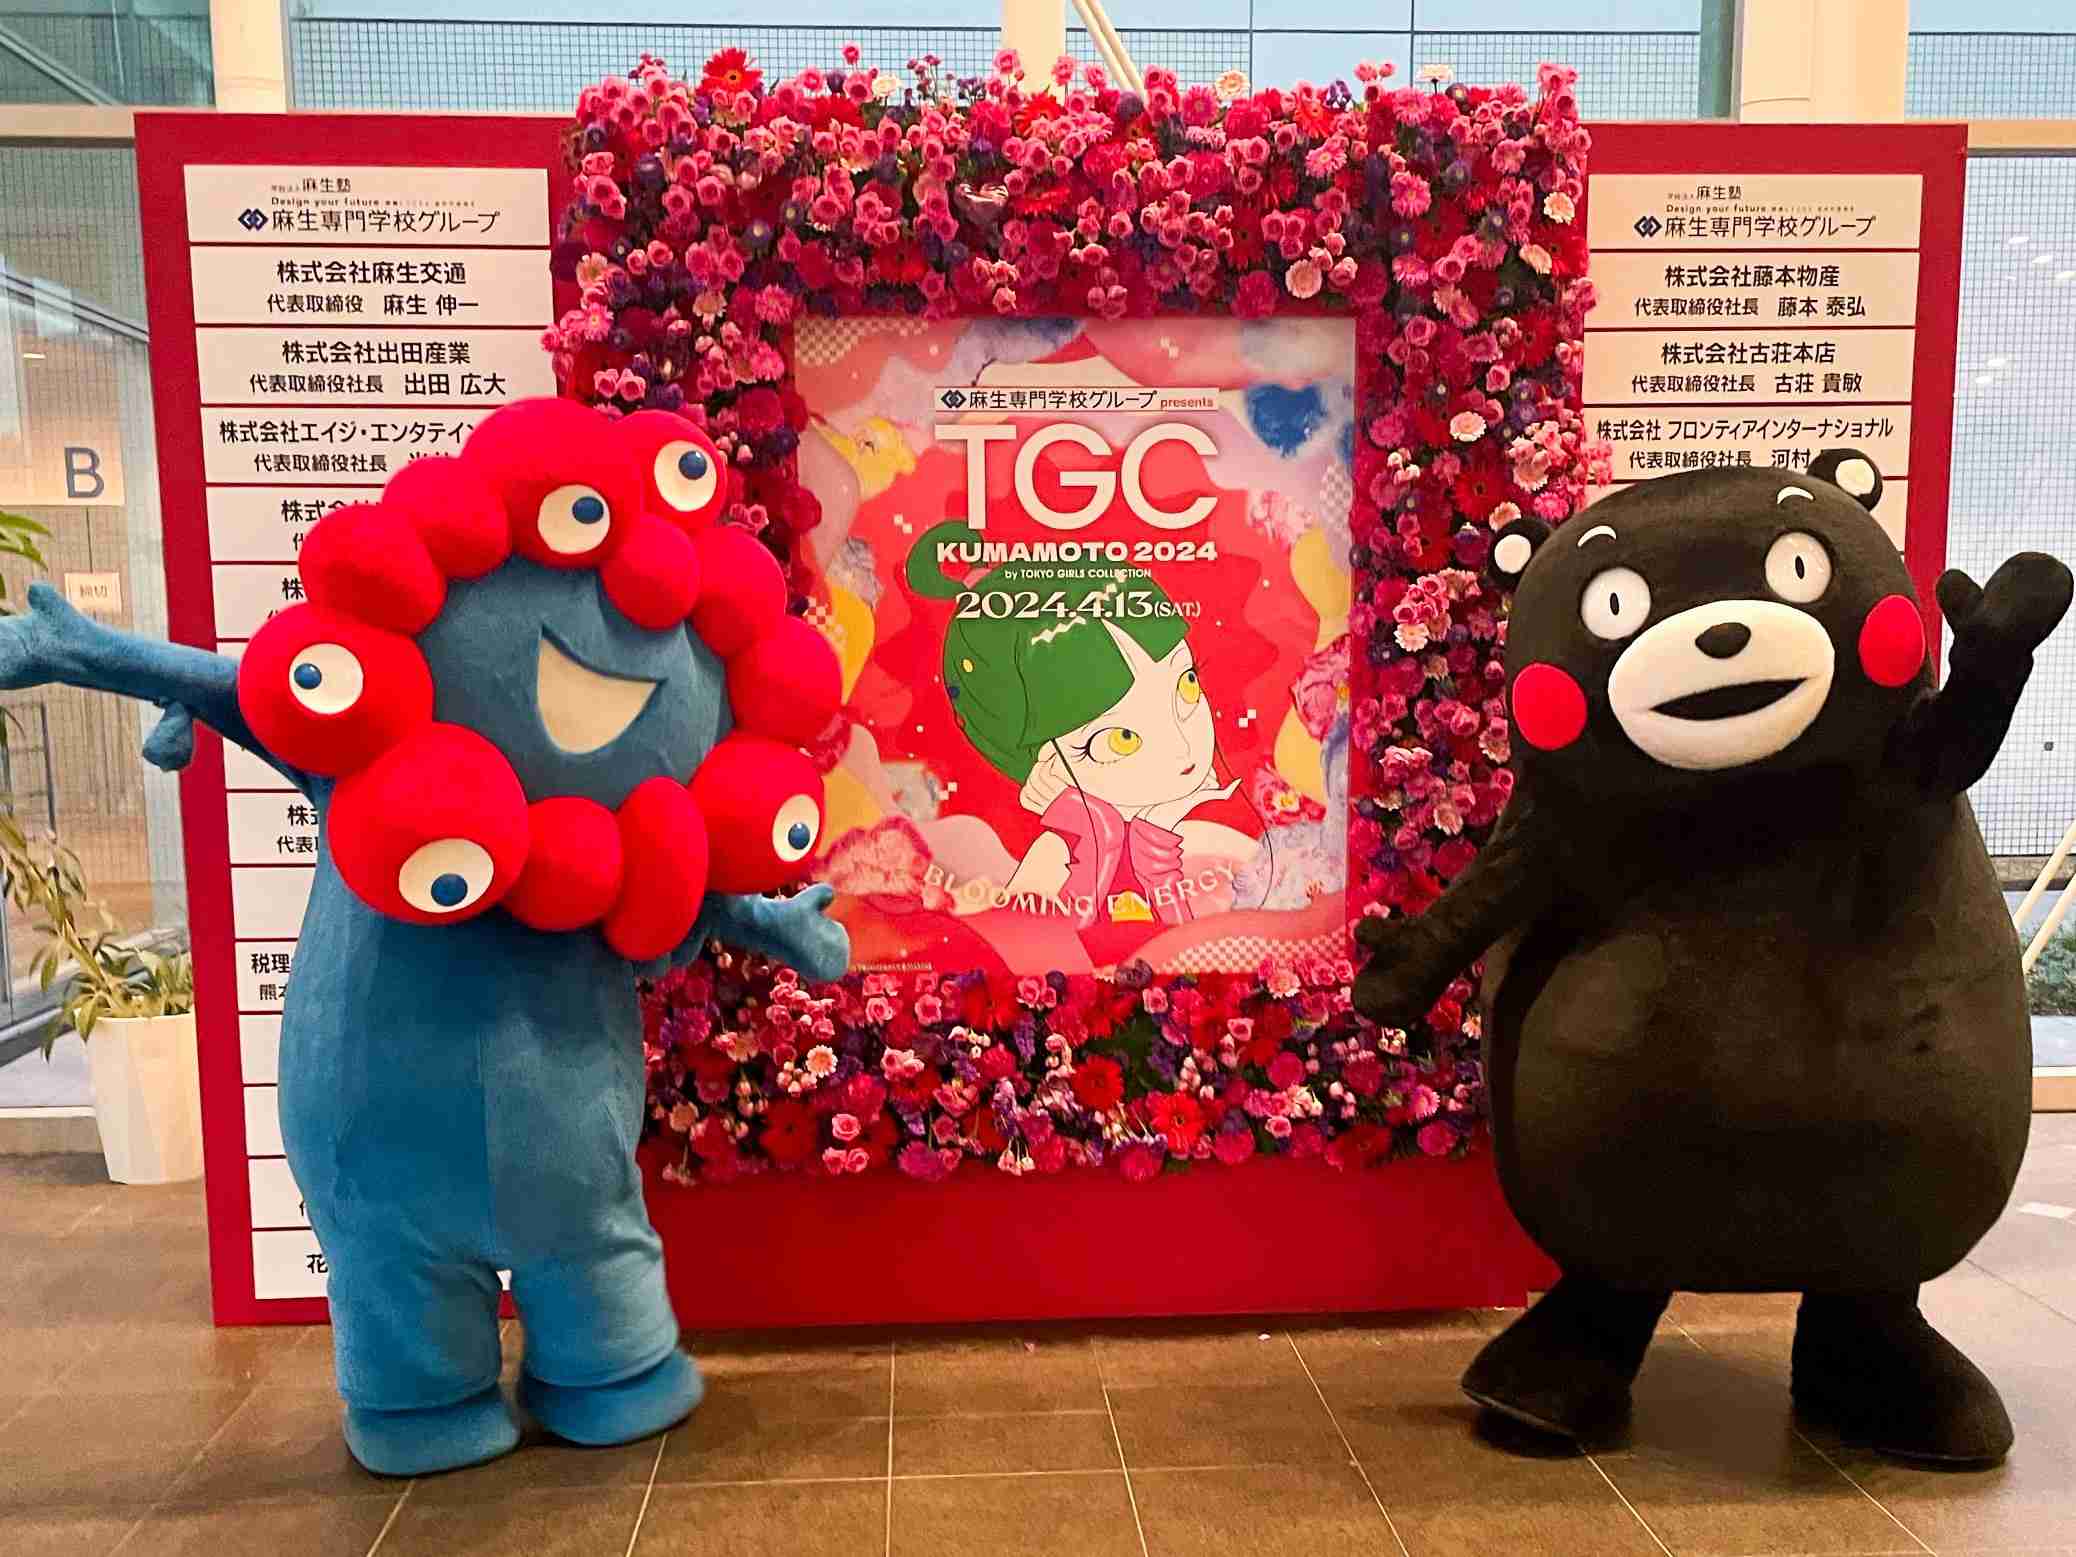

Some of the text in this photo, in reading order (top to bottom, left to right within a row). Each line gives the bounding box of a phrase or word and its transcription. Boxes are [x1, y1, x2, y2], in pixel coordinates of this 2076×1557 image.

[271, 197, 309, 207] Design
[1696, 185, 1742, 201] 麻生塾
[1666, 204, 1701, 214] Design
[1706, 205, 1729, 215] your
[1734, 203, 1766, 212] future
[272, 209, 501, 233] 麻生専門学校グループ
[1664, 215, 1876, 238] 麻生専門学校グループ
[277, 261, 466, 284] 株式会社麻生交通
[1664, 265, 1840, 288] 株式会社藤本物産
[267, 295, 479, 316] 代表取締役 麻生 伸一
[1634, 297, 1866, 317] 代表取締役社長 藤本 泰弘
[282, 341, 471, 365] 株式会社出田産業
[1661, 342, 1836, 365] 株式会社古荘本店
[250, 373, 506, 396] 代表取締役社長 出田 広大
[1631, 373, 1862, 394] 代表取締役社長 古荘 貴敏
[969, 389, 1214, 410] 麻生専門学校グループ presents
[1597, 418, 1894, 441] 株式会社 フロンティアインターナショナル
[254, 453, 388, 473] 代表取締役社長
[1629, 450, 1752, 469] 代表取締役社長
[64, 447, 105, 498] B
[935, 423, 1218, 530] TGC
[937, 541, 1218, 563] KUMAMOTO 2024
[1005, 568, 1151, 580] by TOKYO GIRLS COLLECTION
[922, 863, 1237, 917] BLOOMING ENERGY
